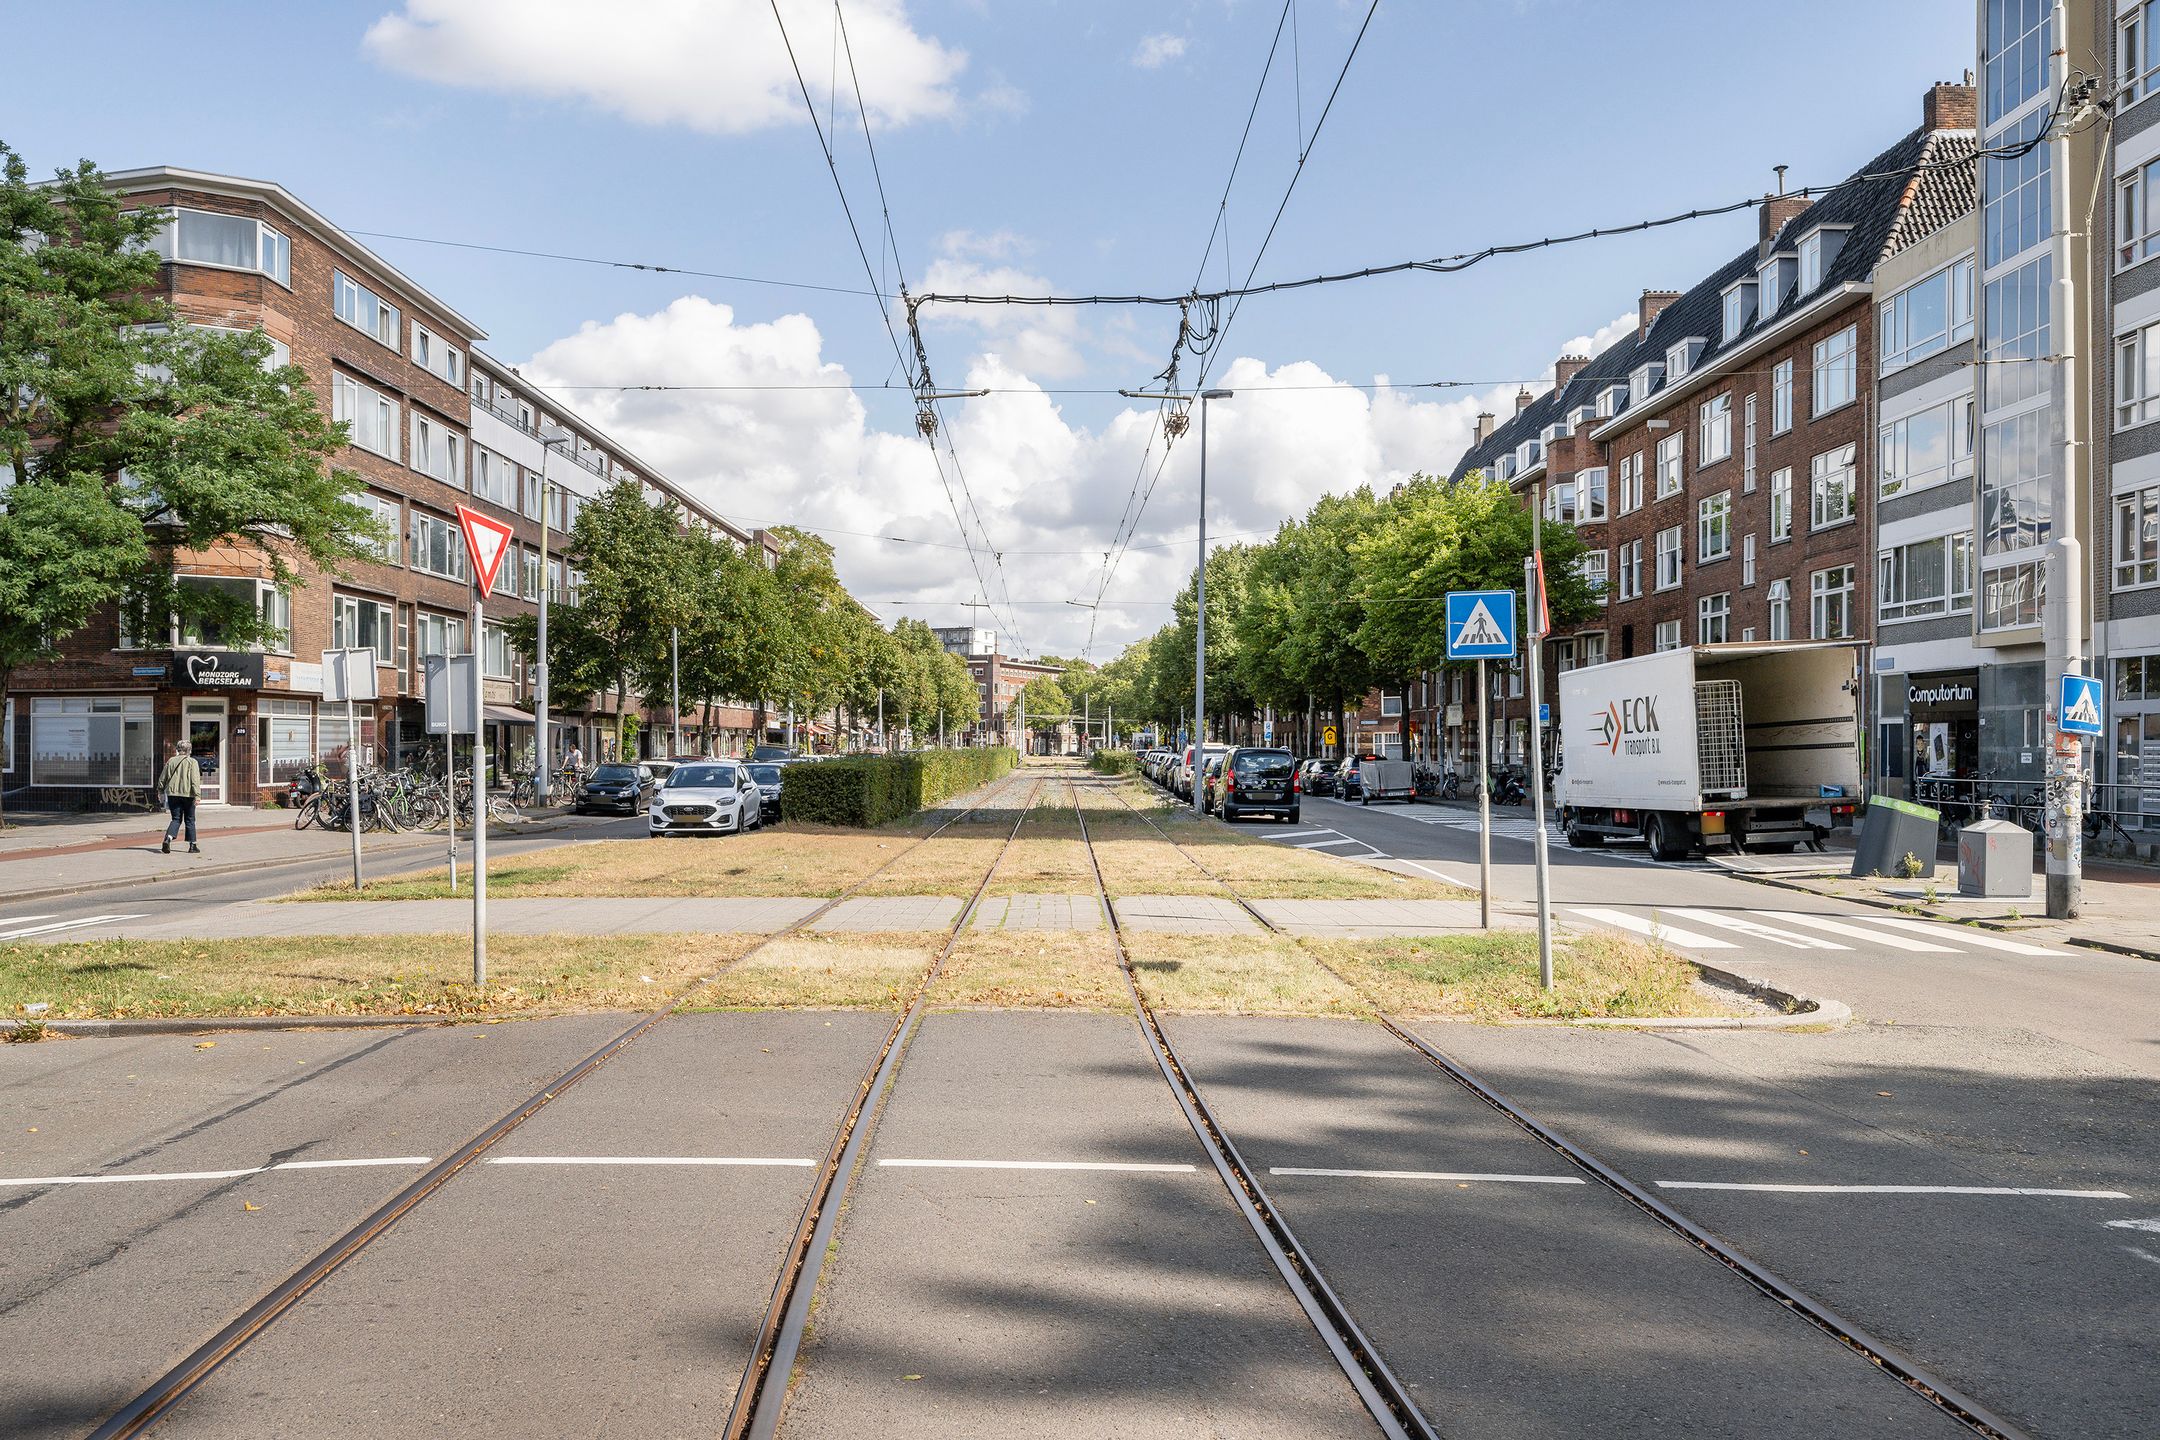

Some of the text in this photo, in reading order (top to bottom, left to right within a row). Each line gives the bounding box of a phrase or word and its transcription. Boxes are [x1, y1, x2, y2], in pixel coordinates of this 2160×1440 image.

[198, 678, 252, 686] BERGSELAAN
[1908, 683, 1973, 706] Computorium
[1622, 694, 1659, 734] ECK
